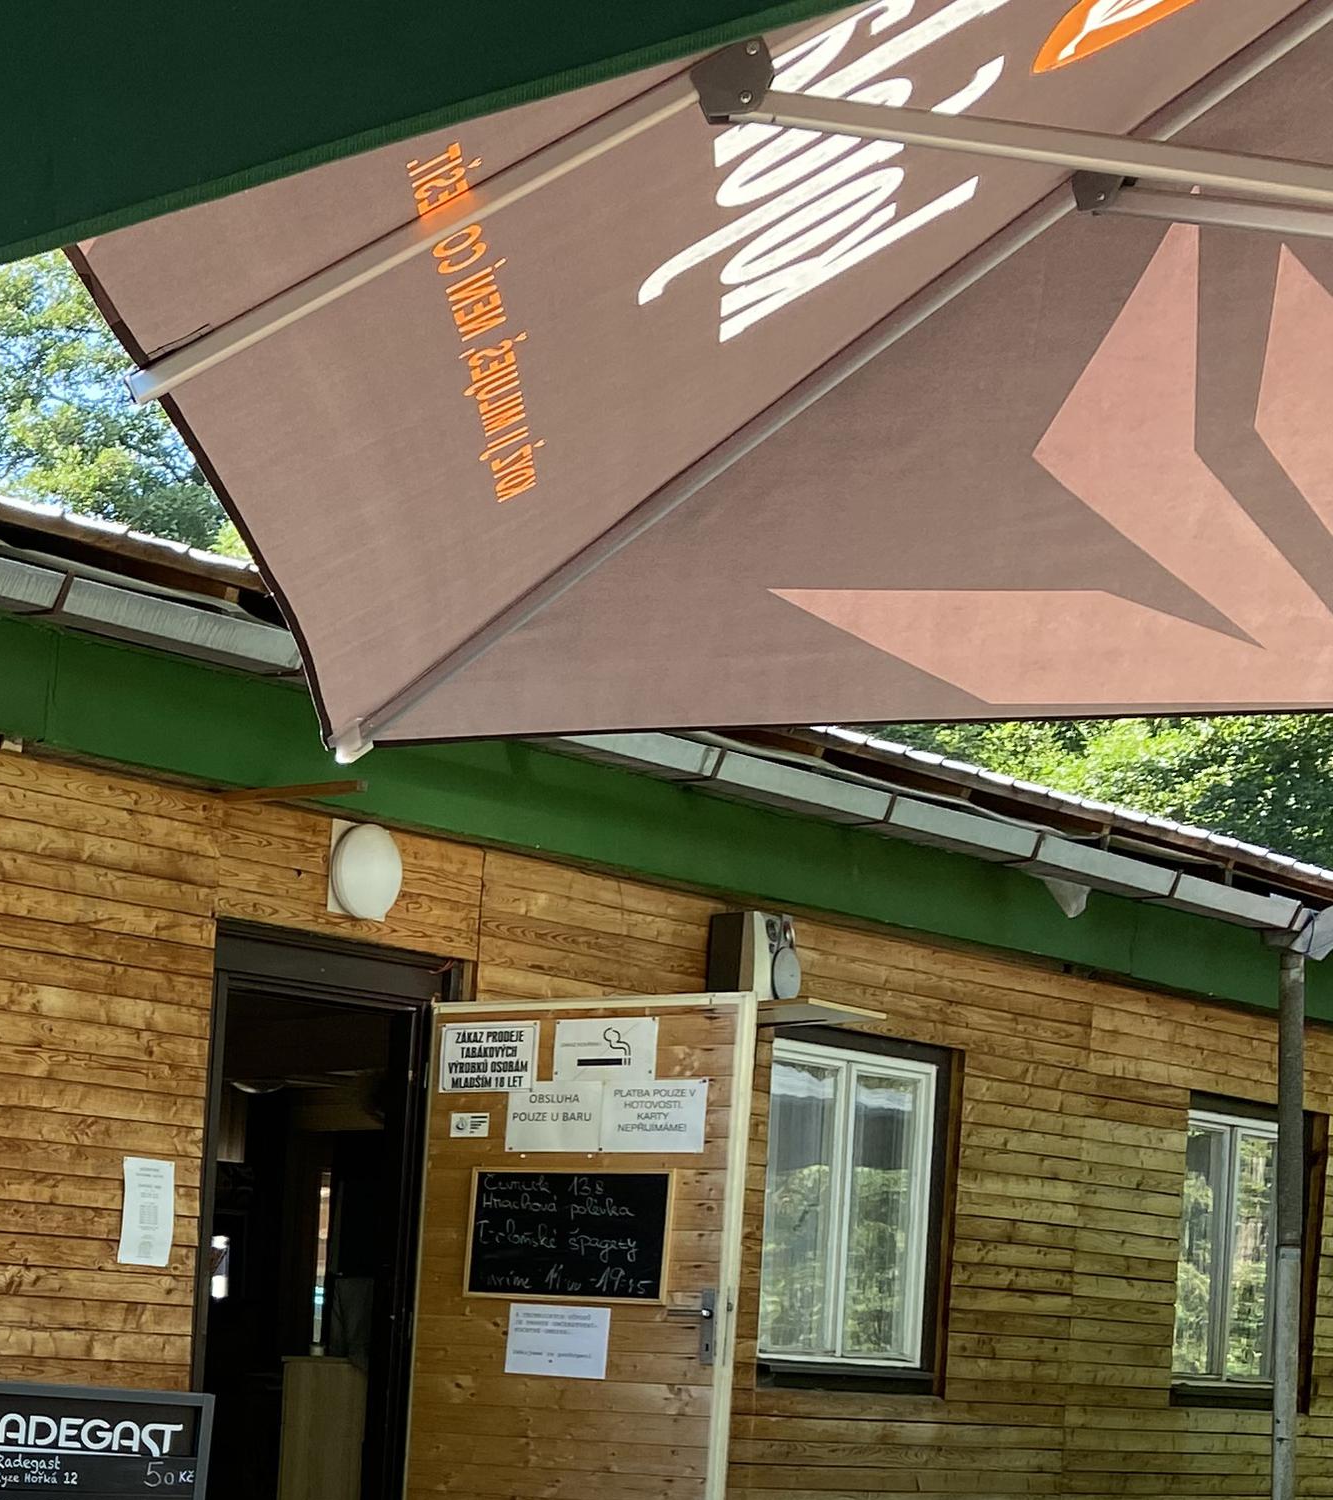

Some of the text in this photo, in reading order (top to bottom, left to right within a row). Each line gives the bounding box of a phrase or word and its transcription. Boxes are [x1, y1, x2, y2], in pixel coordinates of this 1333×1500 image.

[455, 1030, 525, 1043] ZÁKAZ PRODEJE
[460, 1045, 518, 1058] TABÁKOVÝCH
[448, 1059, 528, 1073] VÝROBKŮ OSOBÁM
[451, 1074, 524, 1088] MLADŠÍM 18 LET
[529, 1094, 580, 1105] OBSLUHA
[613, 1088, 697, 1098] PLATBA POUZE V
[512, 1112, 592, 1122] POUZE U BARU
[636, 1112, 670, 1120] KARTY
[24, 1470, 58, 1484] Hořká
[63, 1471, 78, 1485] 12
[179, 1471, 195, 1484] Kč
